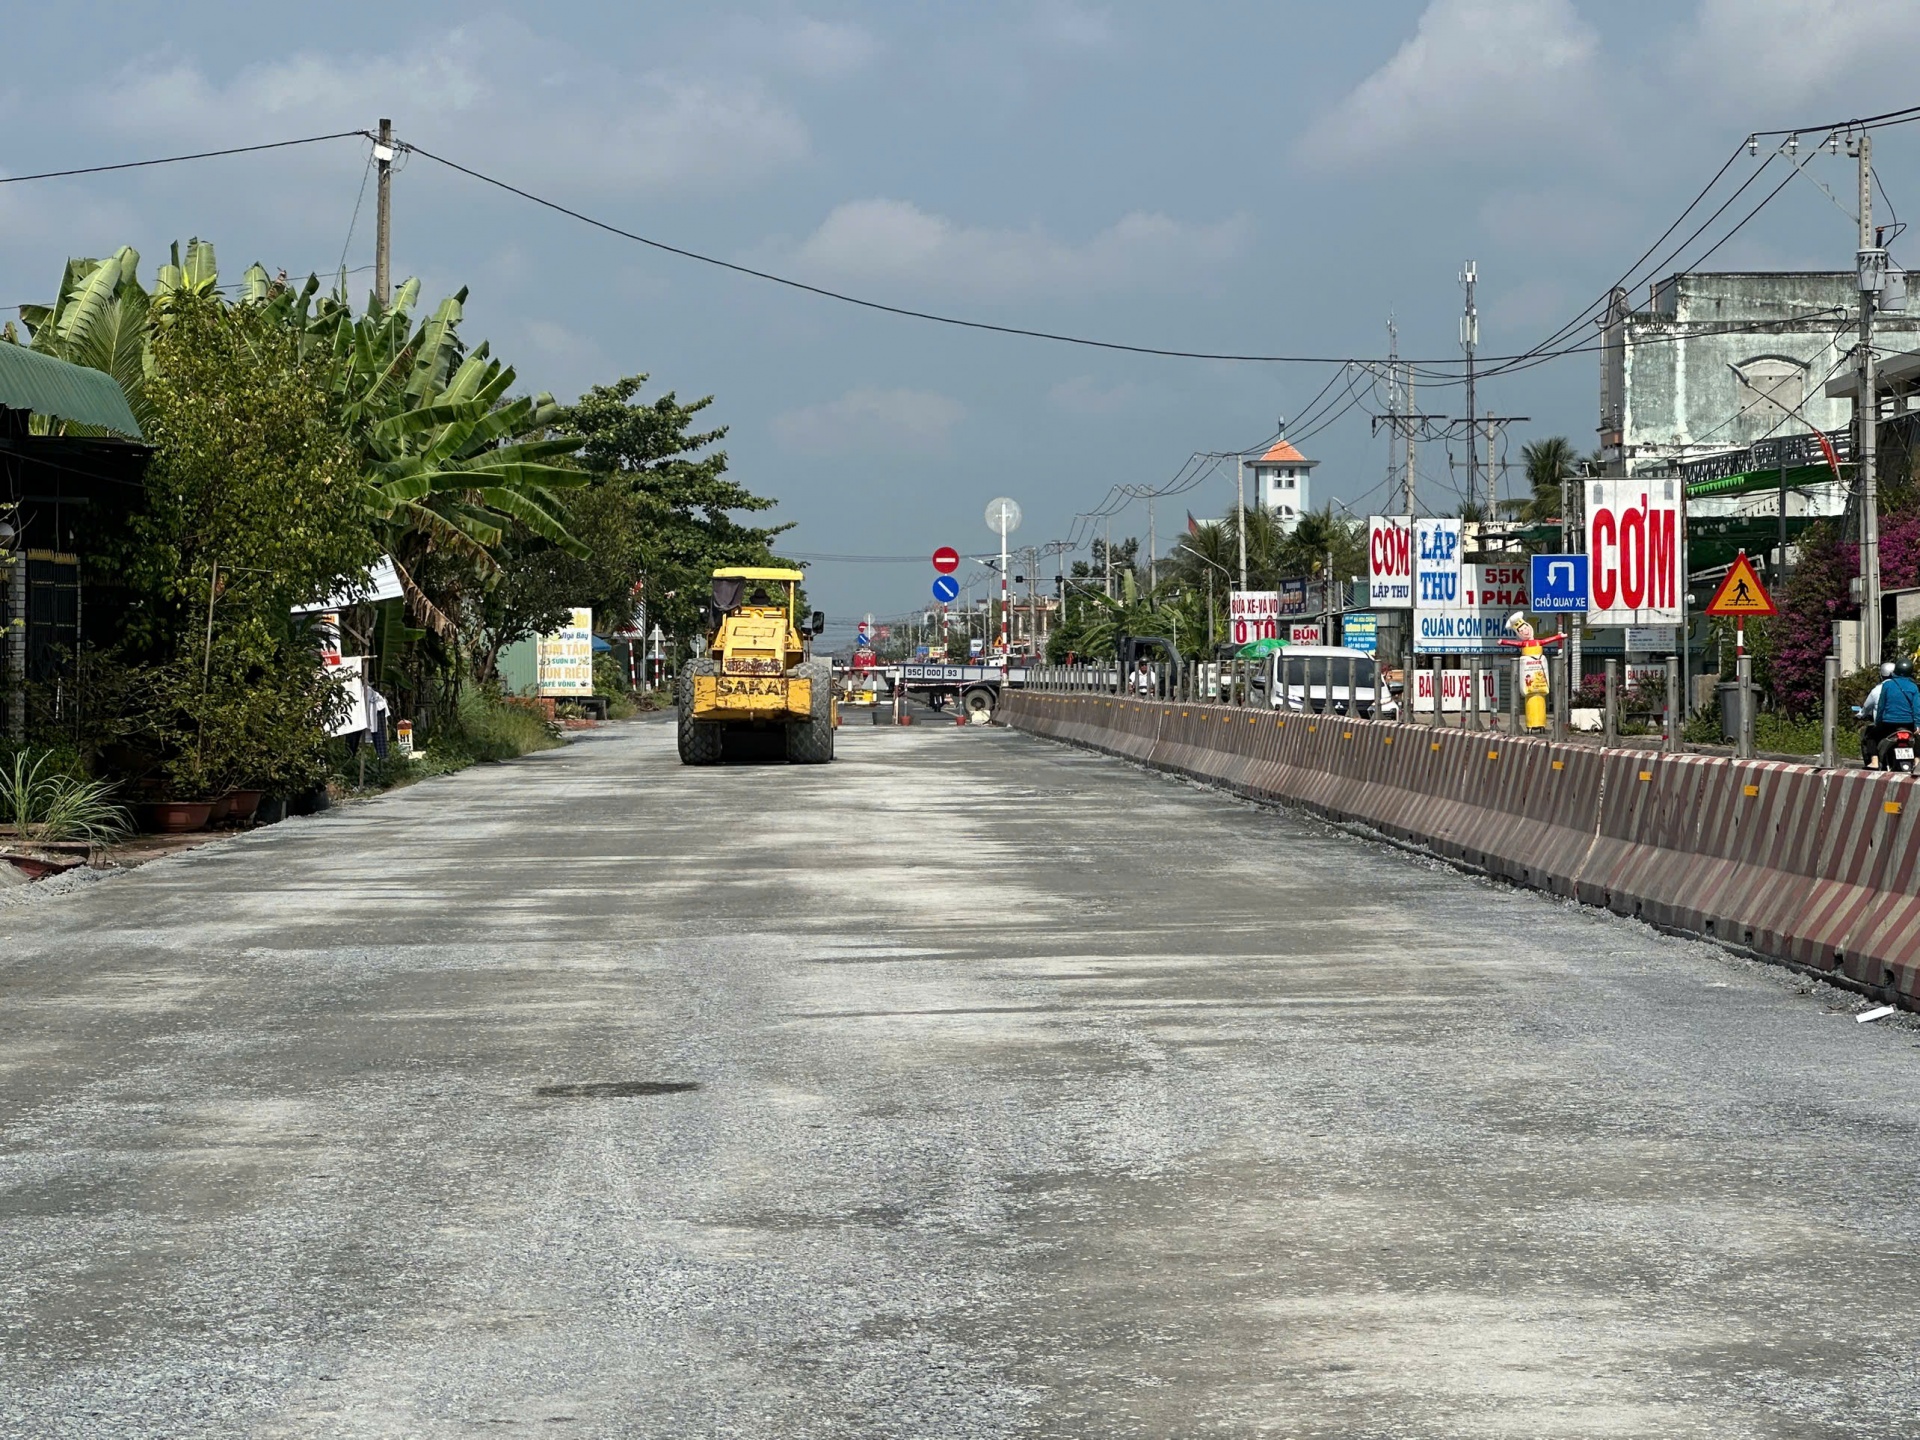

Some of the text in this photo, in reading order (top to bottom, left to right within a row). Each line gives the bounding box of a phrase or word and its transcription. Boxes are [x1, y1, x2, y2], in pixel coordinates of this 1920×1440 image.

[1371, 518, 1410, 577] CƠM
[1420, 523, 1457, 567] LẬP
[1592, 492, 1676, 611] CƠM
[1420, 572, 1457, 600] THU
[1484, 568, 1525, 584] 55K
[1372, 582, 1409, 601] LẬP THU
[1466, 590, 1475, 605] 1
[1534, 593, 1586, 608] CHỖ QUAY XE
[1231, 594, 1246, 614] RỬA
[1268, 593, 1278, 614] VỎ
[1235, 615, 1276, 644] Ô TÔ
[1293, 624, 1318, 640] BÚN
[1421, 612, 1454, 637] QUÁN
[1457, 614, 1482, 637] CƠM
[907, 668, 922, 676] 95C
[926, 669, 941, 677] 000
[717, 679, 788, 696] SAKAI
[1418, 671, 1434, 697] BÃI
[1458, 675, 1471, 697] XE
[1483, 671, 1494, 698] TÔ
